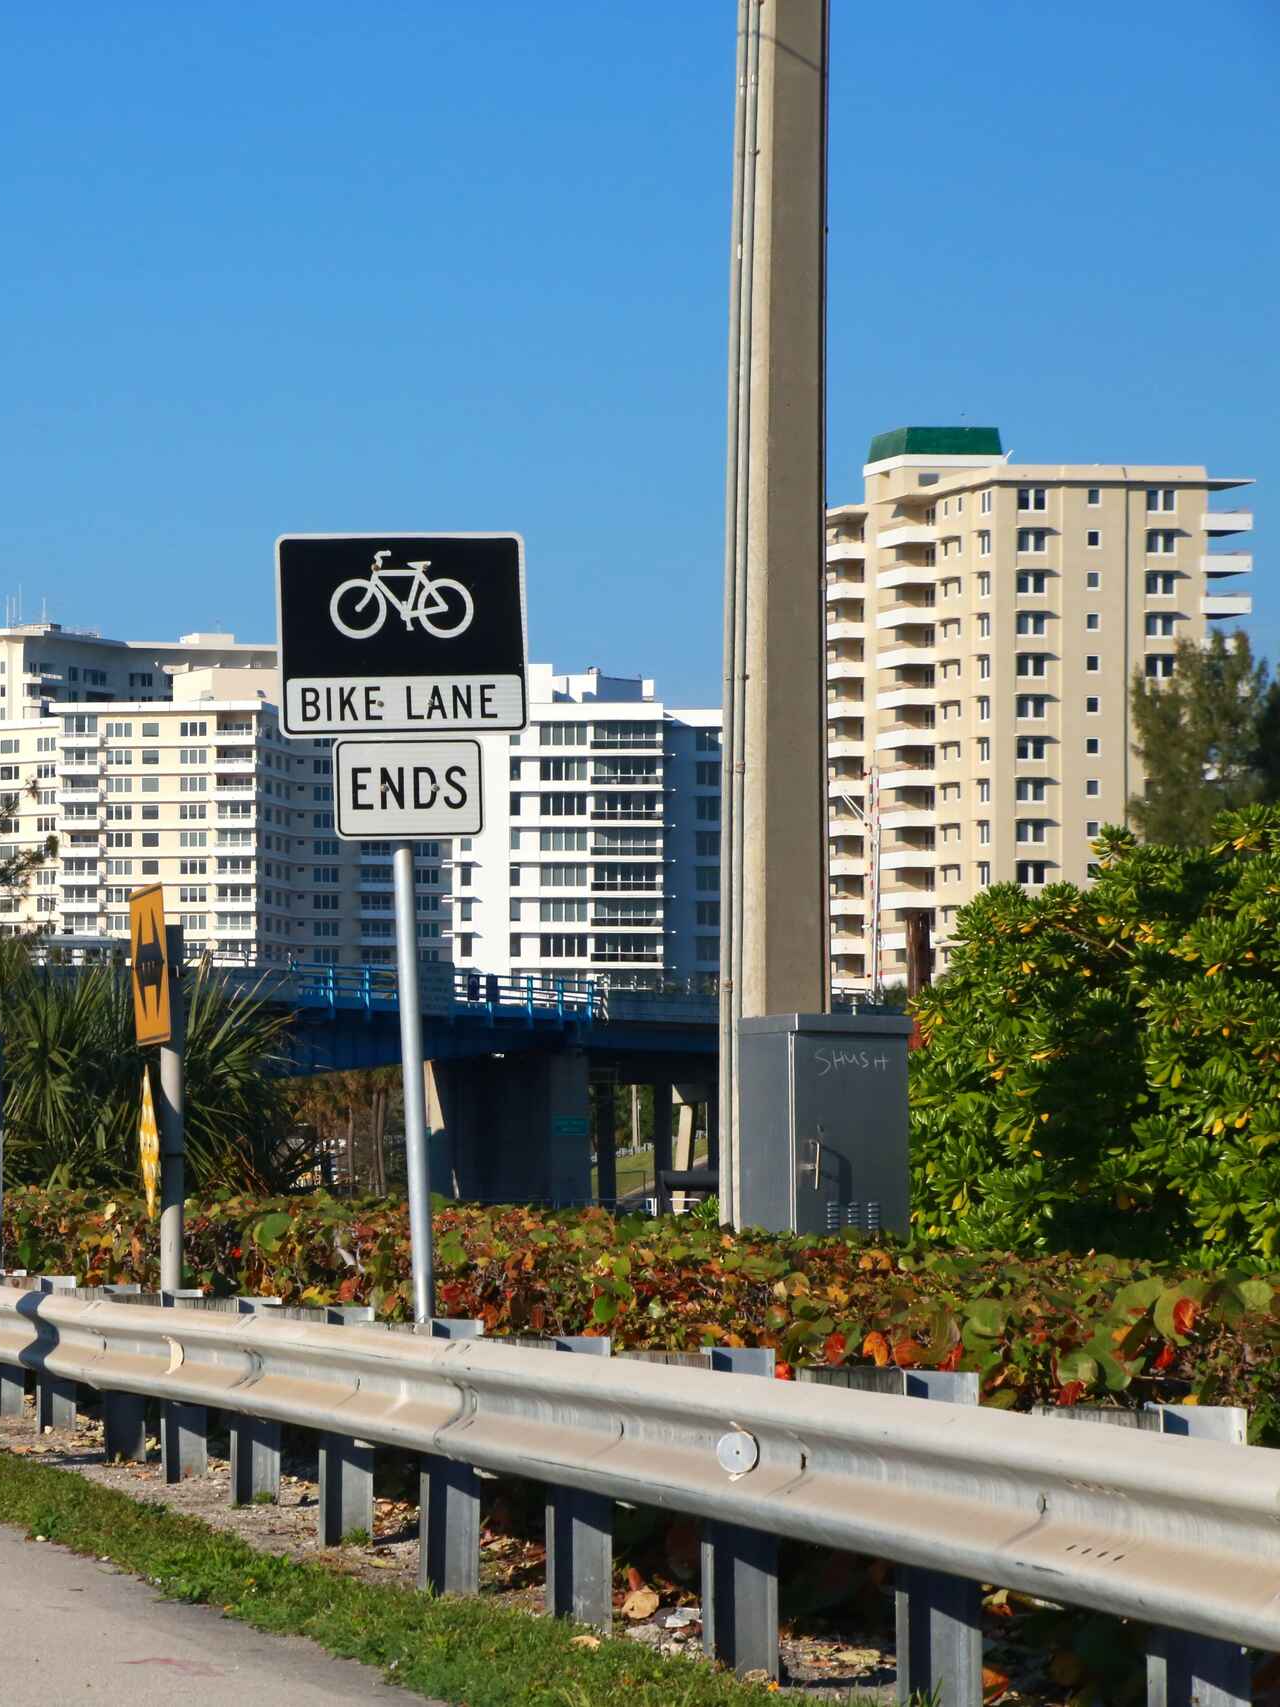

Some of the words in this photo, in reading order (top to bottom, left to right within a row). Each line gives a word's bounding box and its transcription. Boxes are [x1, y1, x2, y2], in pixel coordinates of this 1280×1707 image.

[301, 686, 383, 722] BIKE
[406, 684, 498, 720] LANE
[351, 765, 468, 810] ENDS
[815, 1048, 888, 1076] SHUSH
